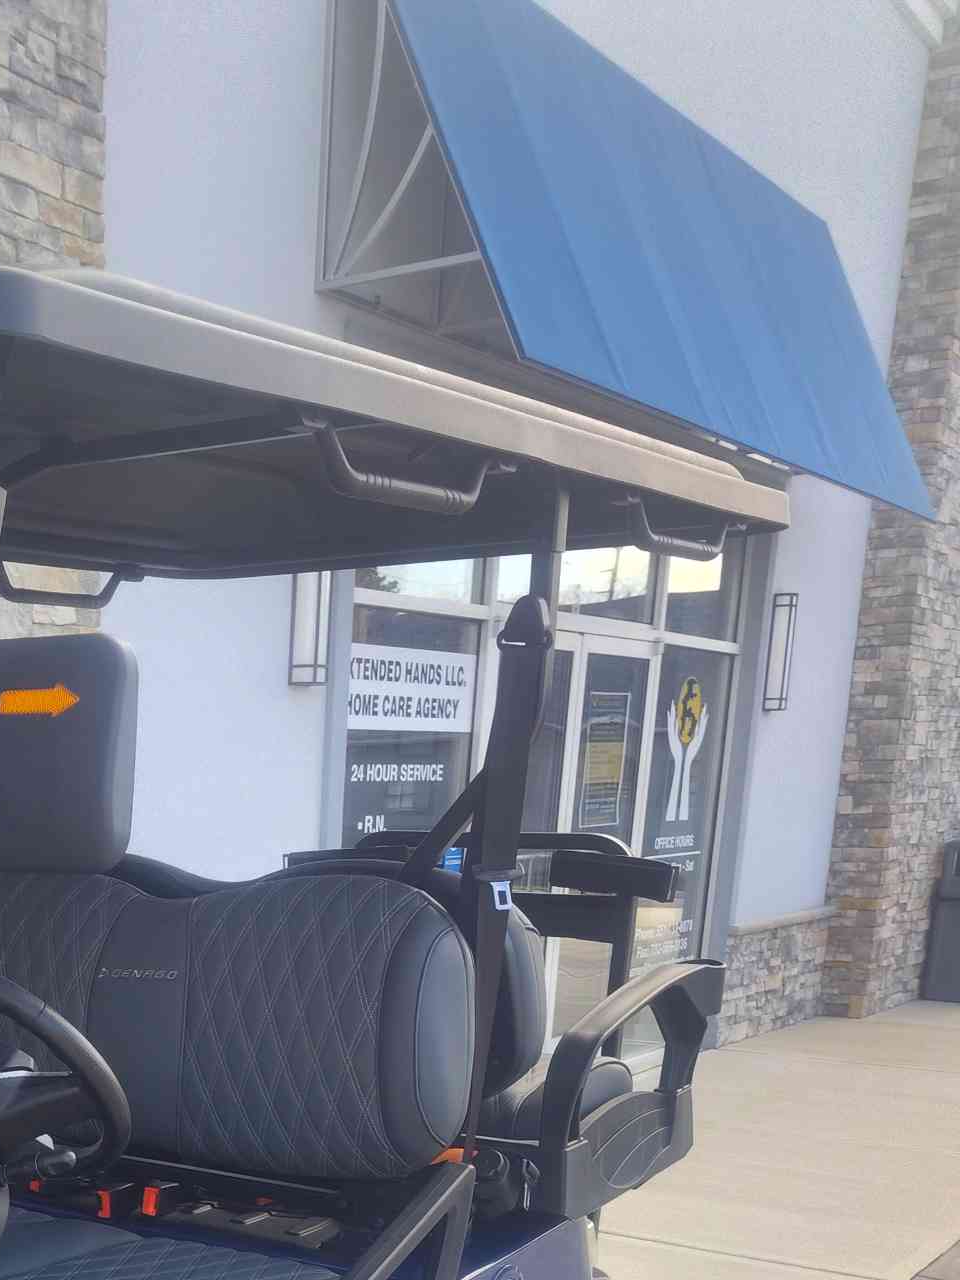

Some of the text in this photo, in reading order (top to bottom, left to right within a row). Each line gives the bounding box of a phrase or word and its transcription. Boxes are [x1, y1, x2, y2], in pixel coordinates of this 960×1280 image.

[404, 661, 442, 685] HANDS
[445, 664, 467, 687] LLC.
[382, 695, 413, 718] CARE
[415, 697, 460, 720] AGENCY
[351, 764, 444, 782] 24 HOUR SERVICE
[654, 834, 695, 849] OFFICE HOURS
